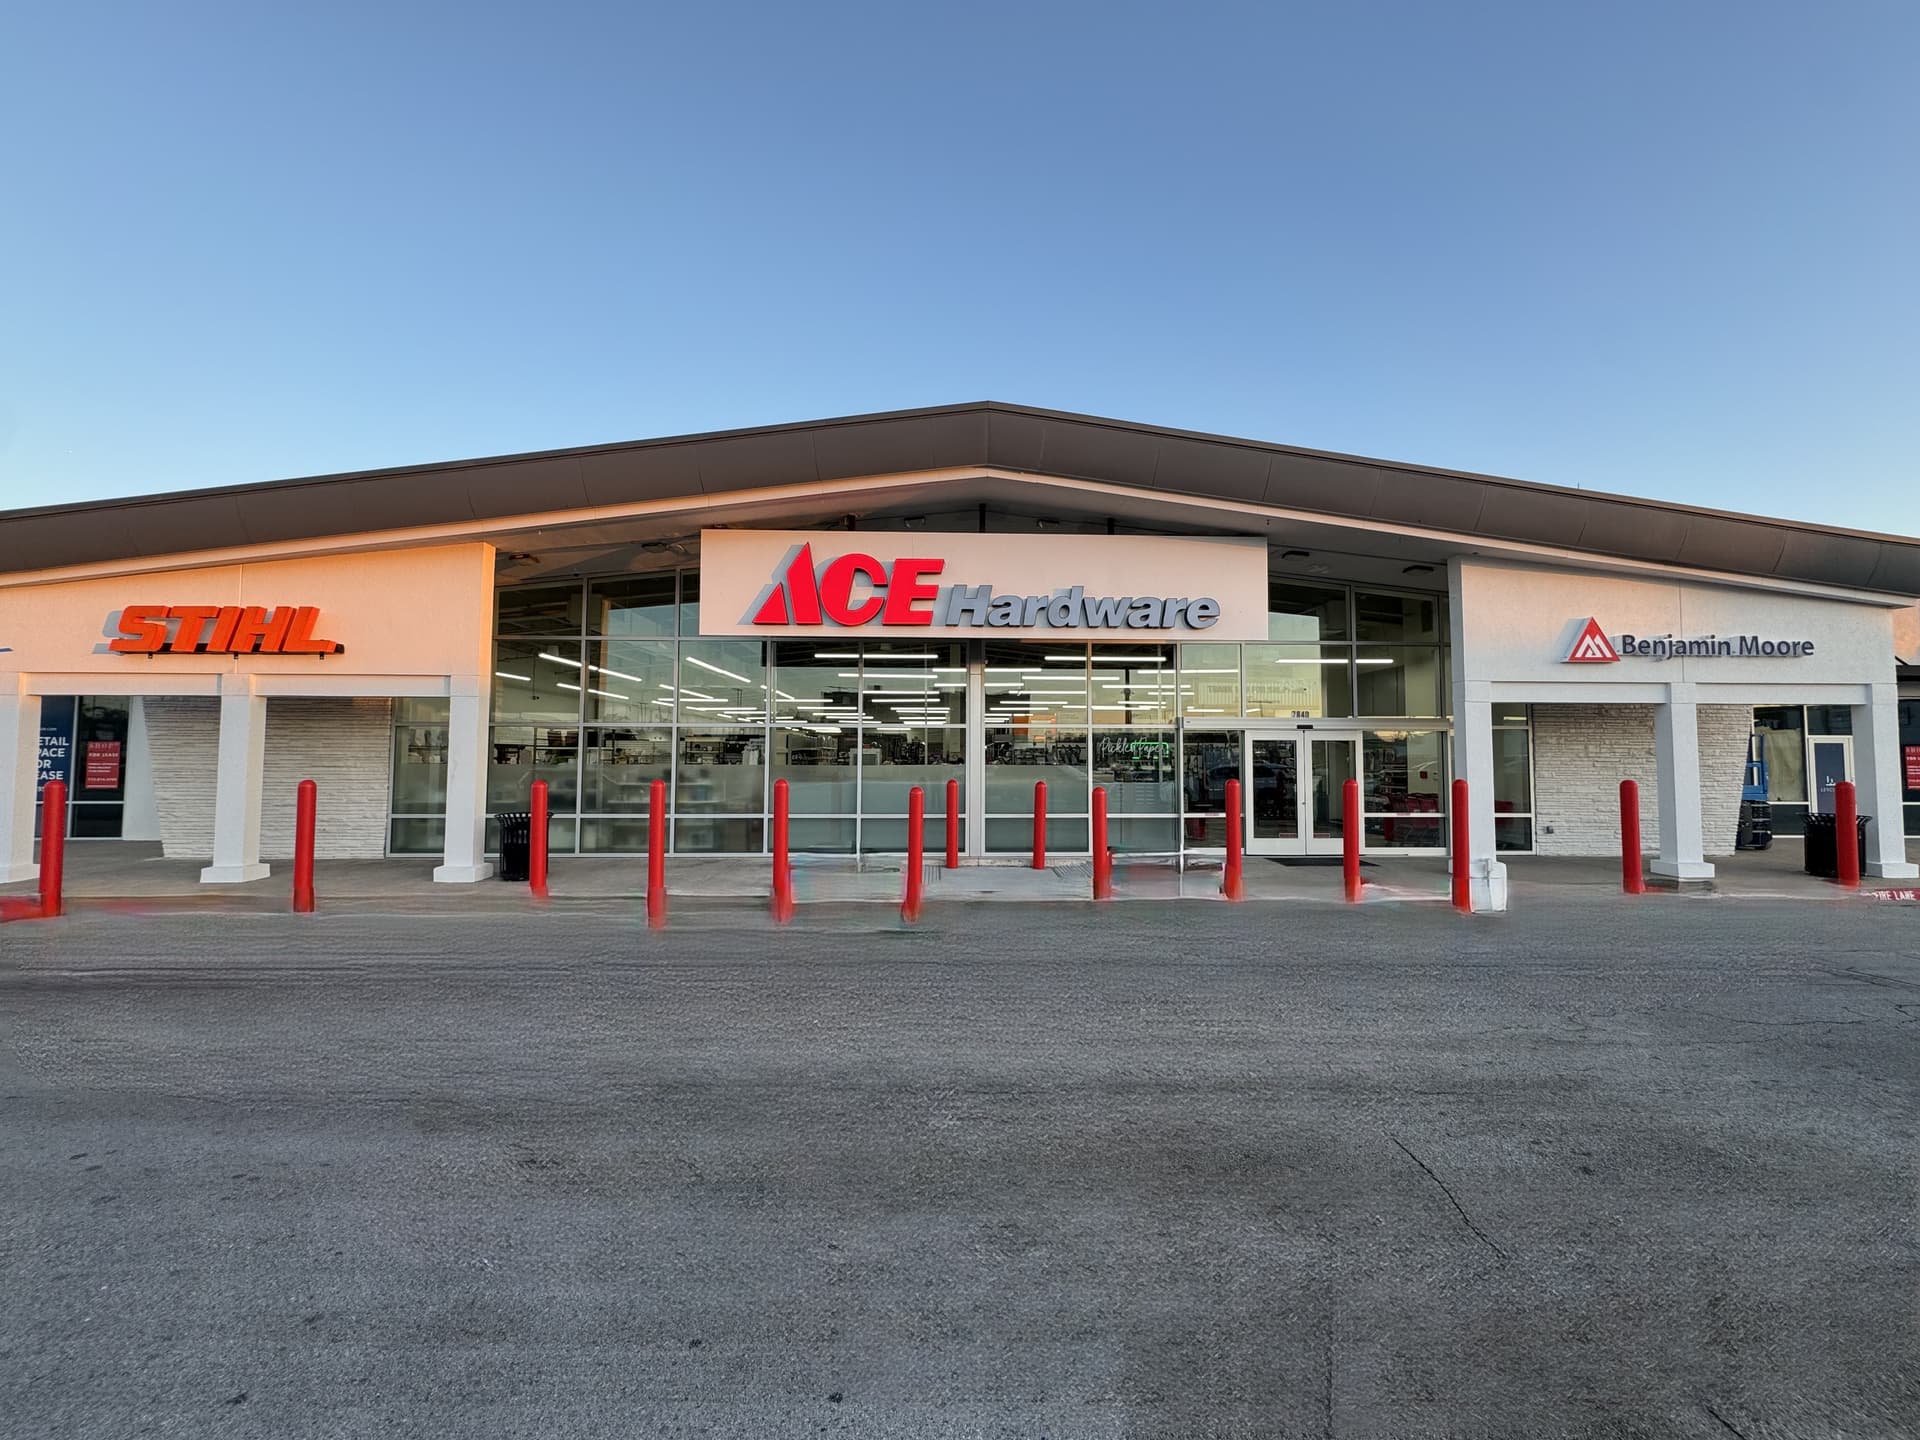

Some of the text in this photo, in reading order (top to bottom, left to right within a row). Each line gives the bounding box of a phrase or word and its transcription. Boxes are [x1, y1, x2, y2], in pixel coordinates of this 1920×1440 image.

[752, 542, 1221, 629] ACE Hardware
[109, 605, 338, 654] STIHL
[1621, 634, 1815, 659] Benjamin Moore
[39, 736, 70, 746] ETAIL
[38, 747, 65, 757] ACE
[37, 759, 52, 769] OR
[37, 770, 64, 780] ASE
